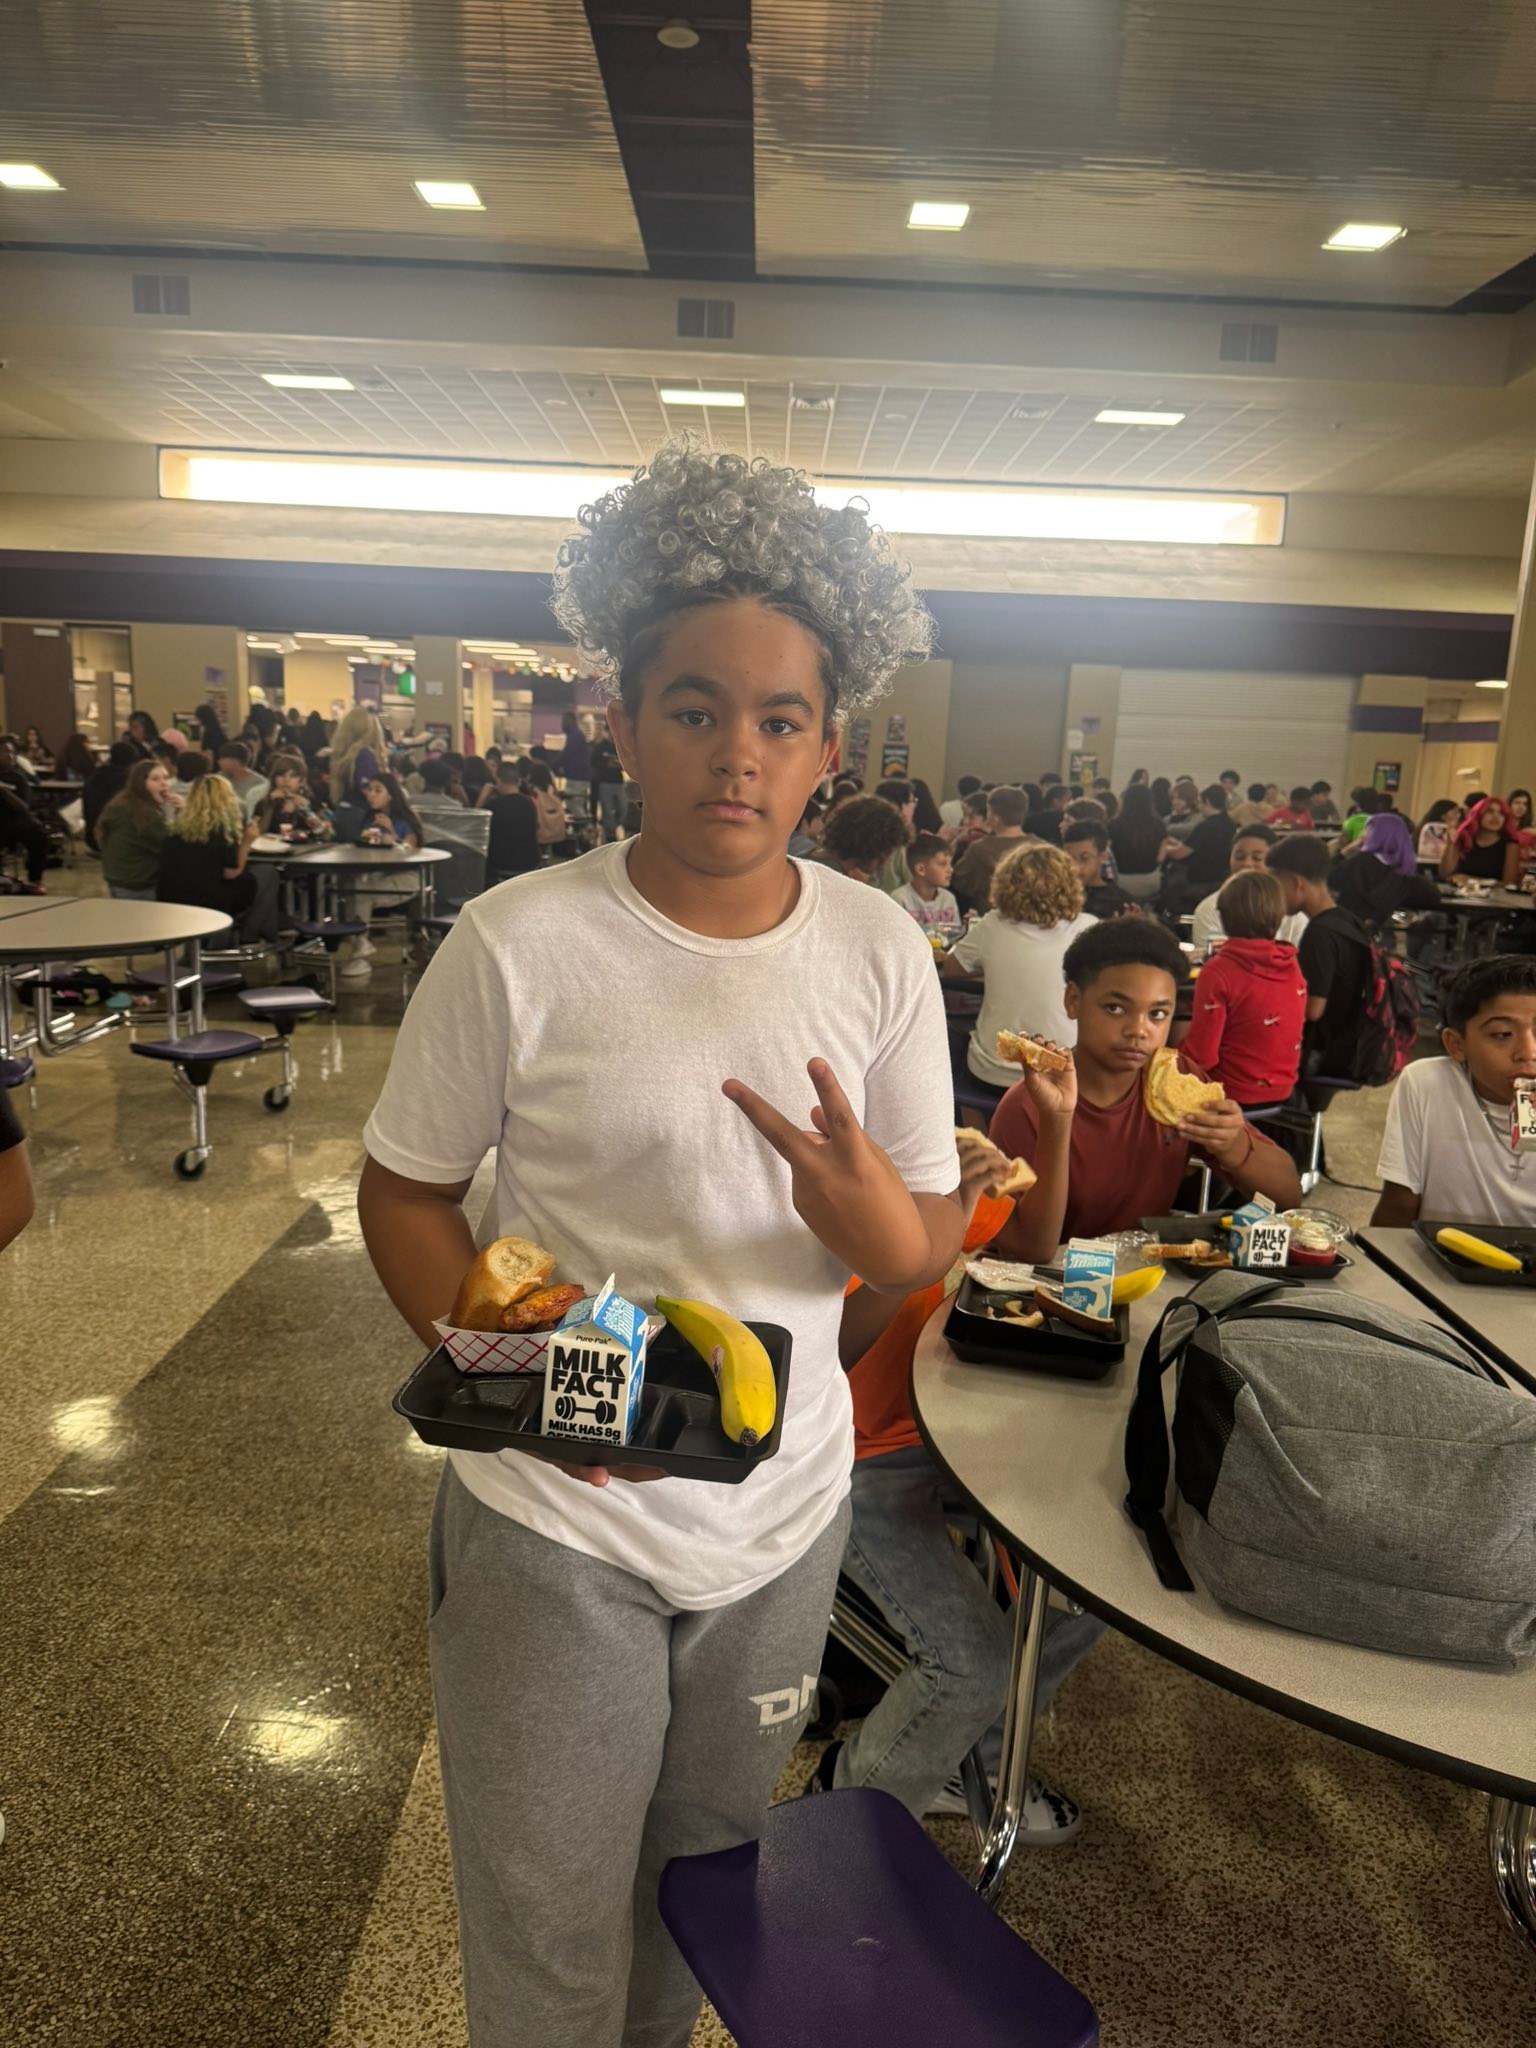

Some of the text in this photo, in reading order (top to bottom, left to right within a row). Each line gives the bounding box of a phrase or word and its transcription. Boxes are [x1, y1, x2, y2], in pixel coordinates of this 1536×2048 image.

[1252, 1240, 1286, 1251] FACT
[1253, 1229, 1287, 1242] MILK
[552, 1345, 627, 1378] MILK
[550, 1368, 626, 1400] FACT
[548, 1419, 578, 1434] MILK
[578, 1423, 603, 1436] HAS
[604, 1427, 621, 1441] 8g
